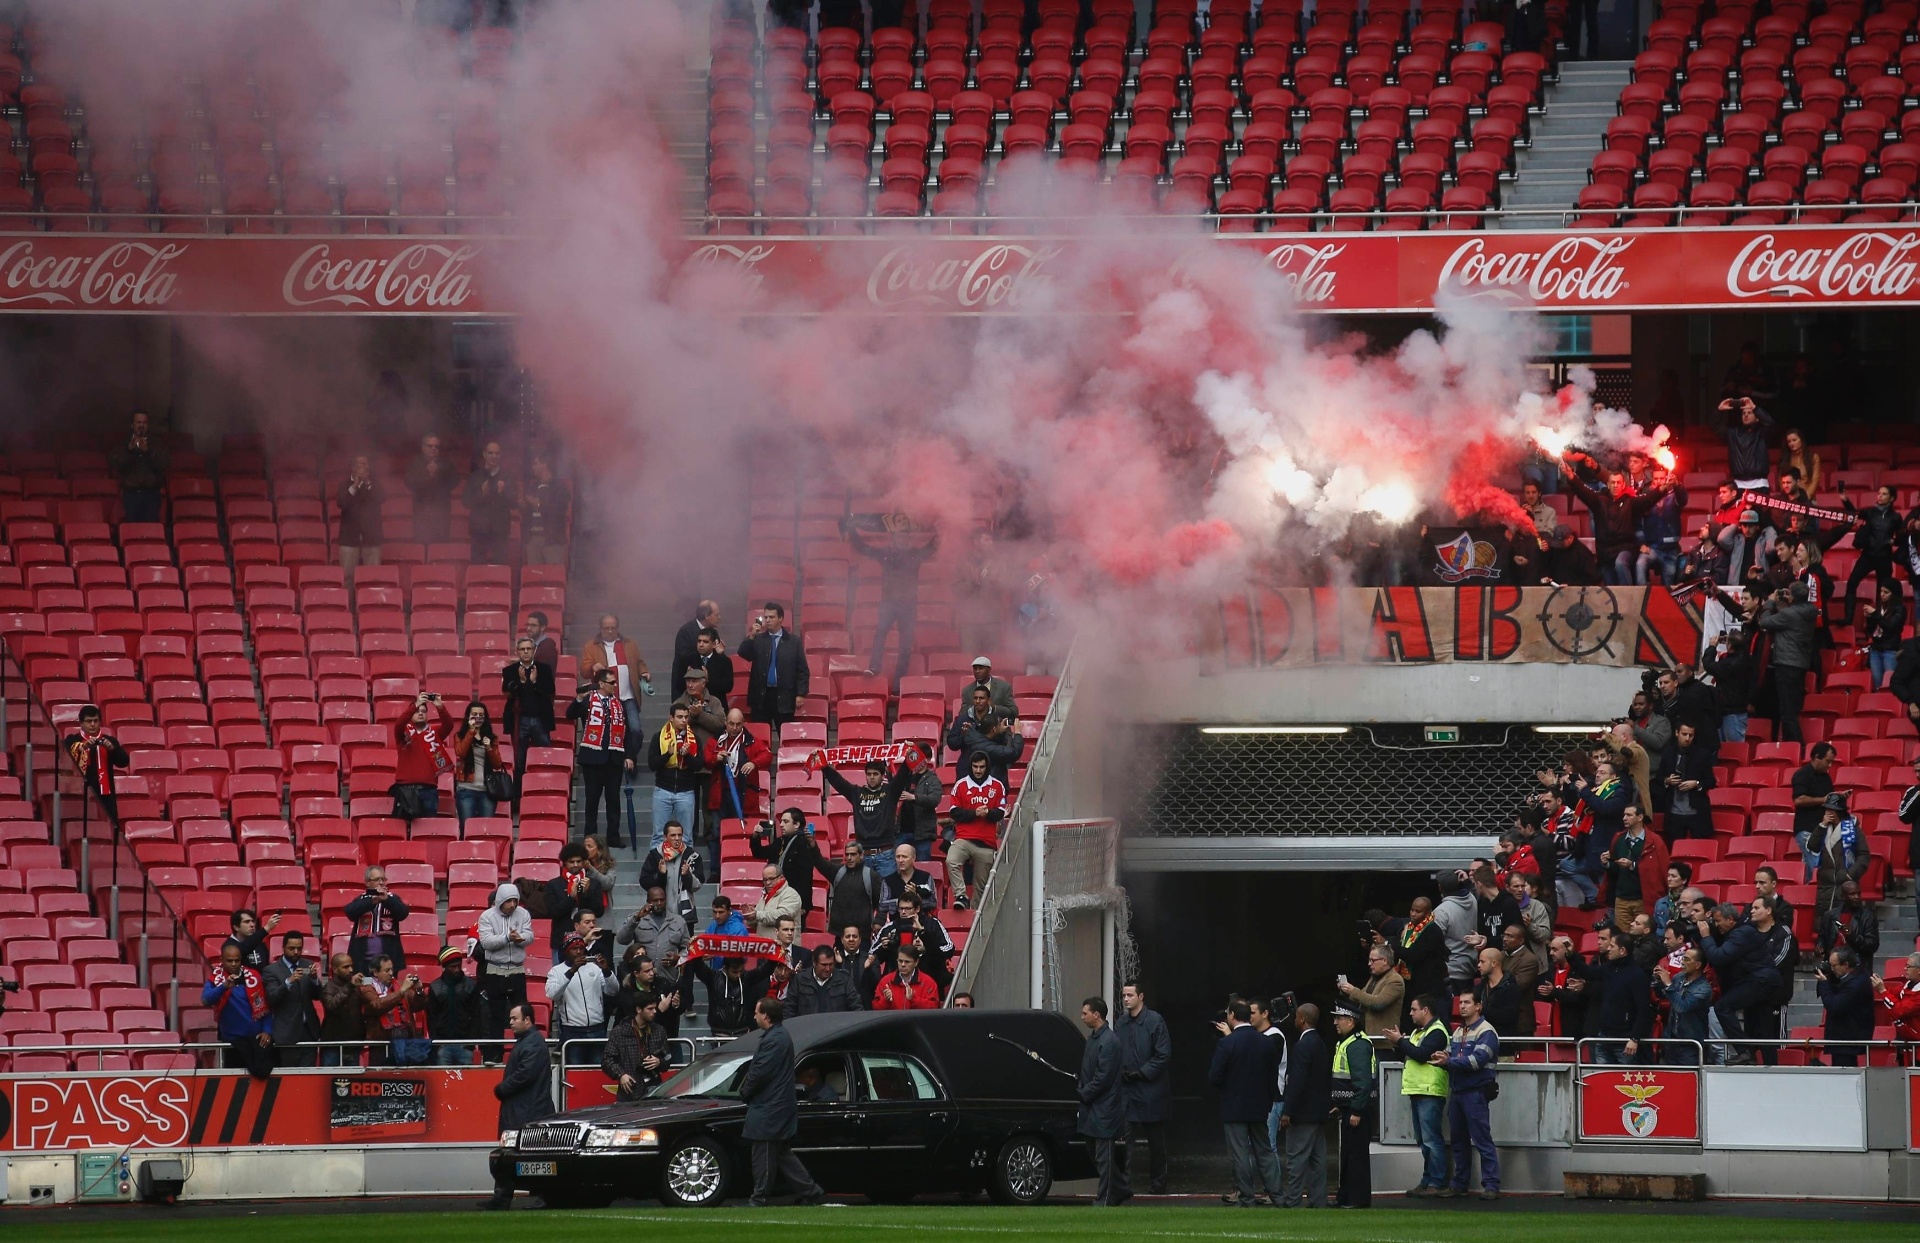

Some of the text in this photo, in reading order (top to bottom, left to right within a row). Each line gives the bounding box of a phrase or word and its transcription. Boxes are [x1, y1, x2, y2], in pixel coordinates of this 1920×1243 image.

[0, 241, 190, 305] Coca-Cola
[282, 243, 483, 307] Coca-Cola
[1438, 237, 1637, 300] Coca-Cola
[1727, 233, 1920, 297] Coca-Cola
[826, 743, 901, 762] BENFICA
[970, 795, 989, 805] meo
[13, 1078, 189, 1149] PASS
